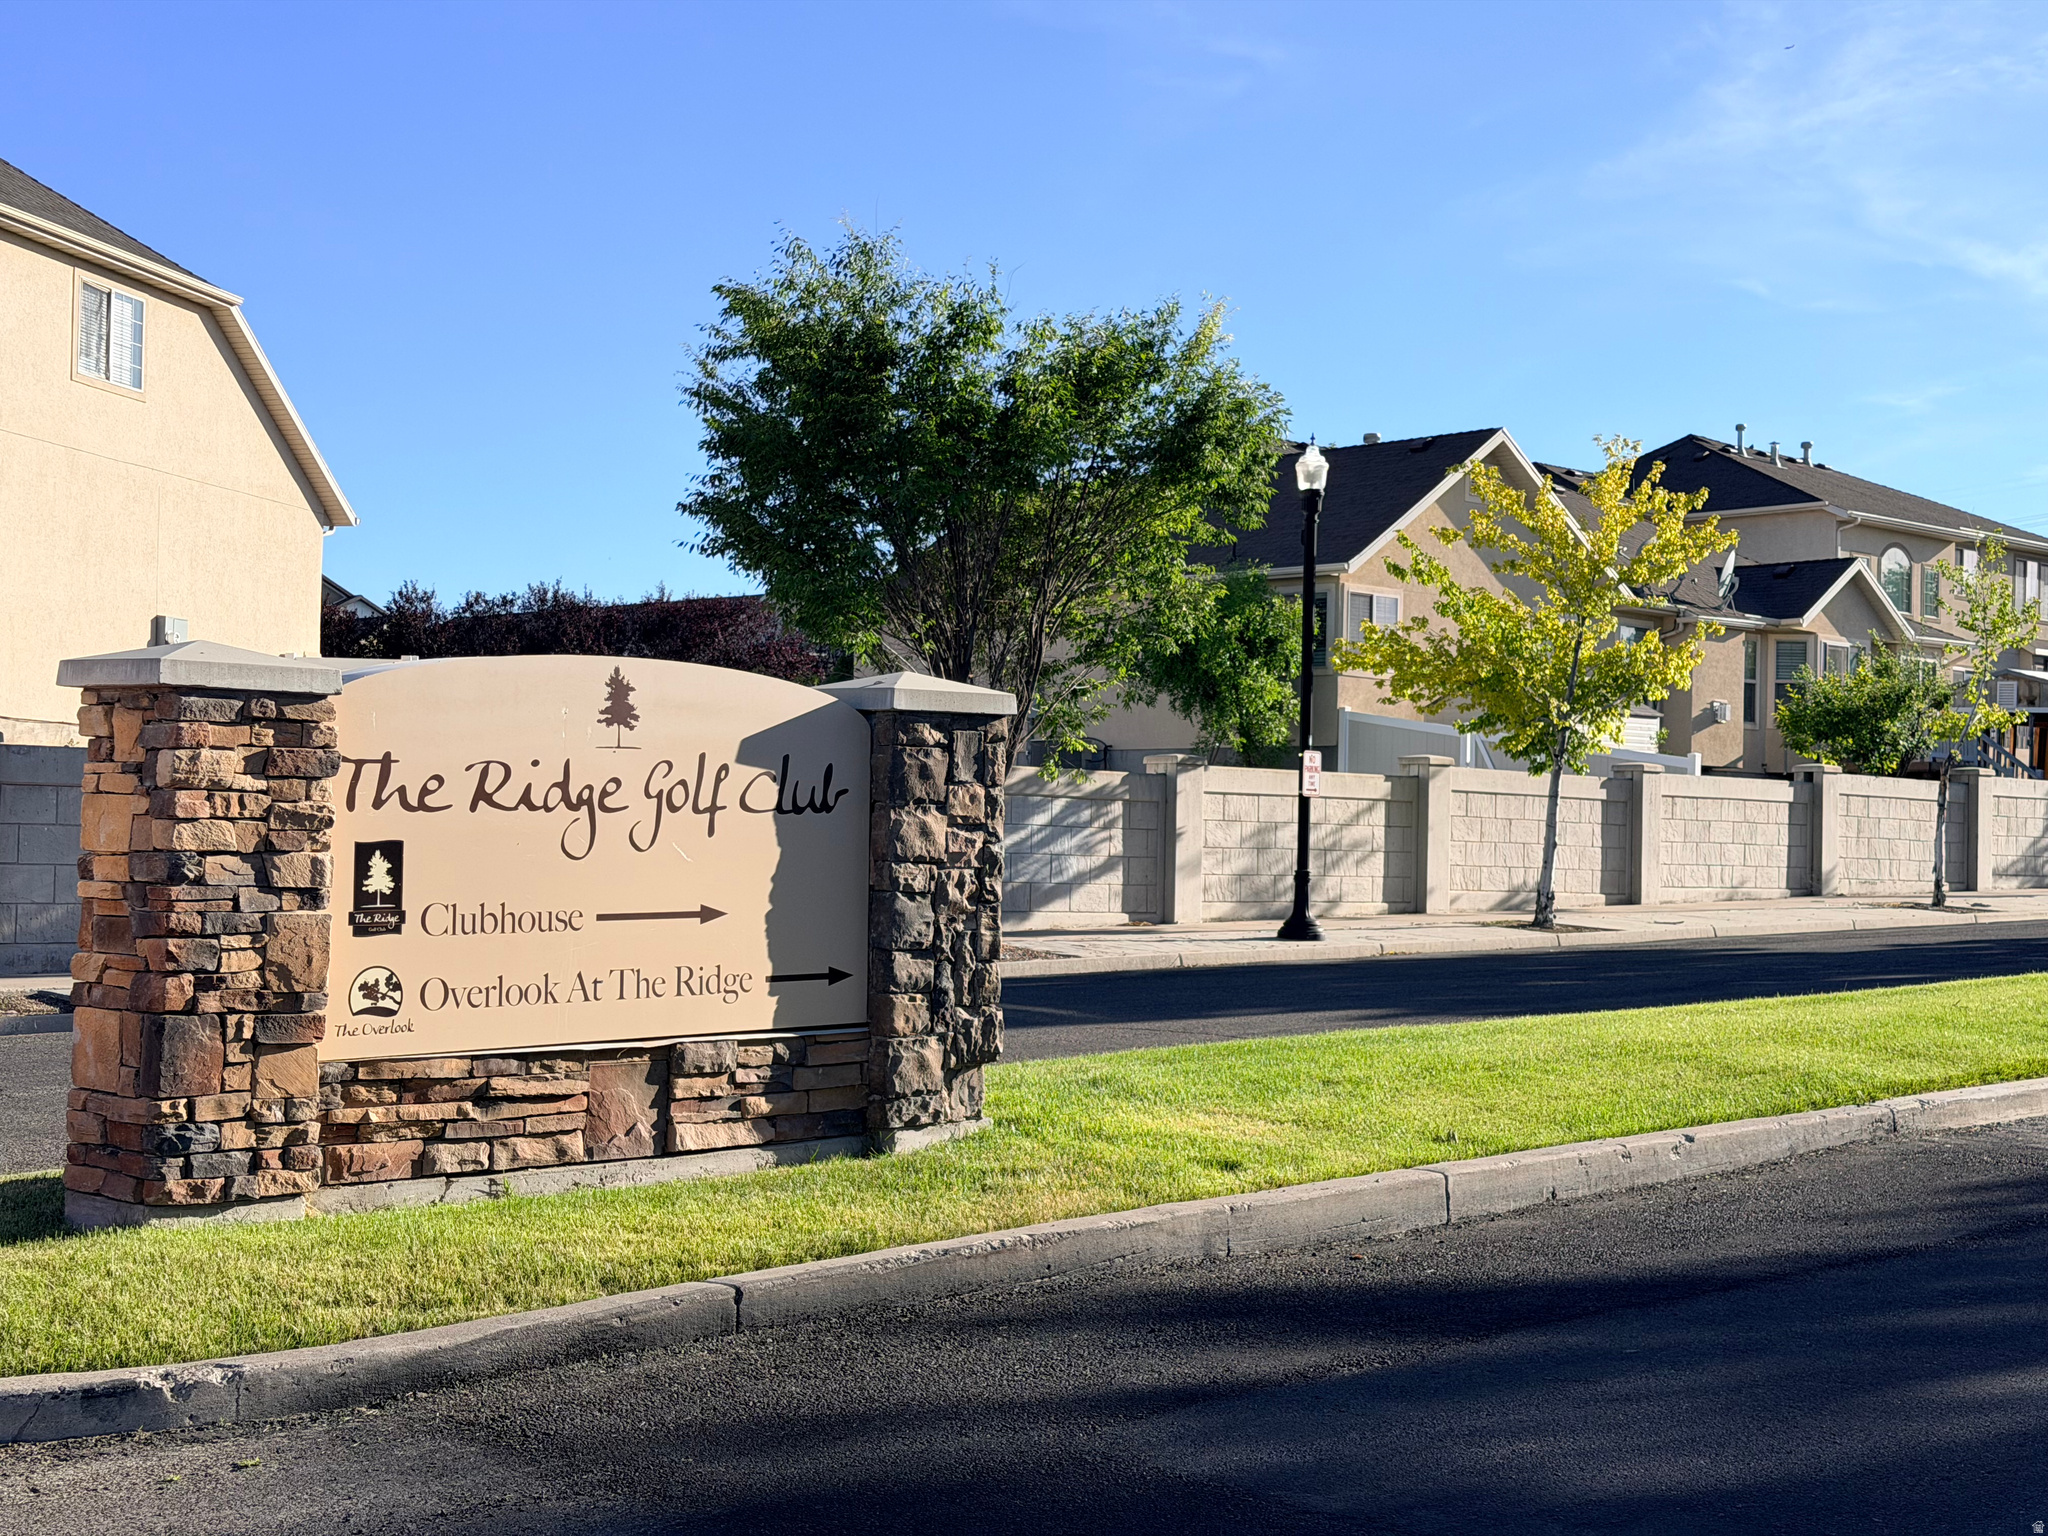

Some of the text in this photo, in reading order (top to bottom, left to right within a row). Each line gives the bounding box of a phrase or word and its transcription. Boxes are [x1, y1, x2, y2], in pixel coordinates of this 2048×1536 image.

[341, 751, 850, 861] The Ridge Golf Club
[354, 912, 400, 929] The Ridge
[420, 901, 585, 937] Clubhouse
[419, 964, 754, 1012] Overlook At The Ridge
[334, 1018, 414, 1039] The Overlook
